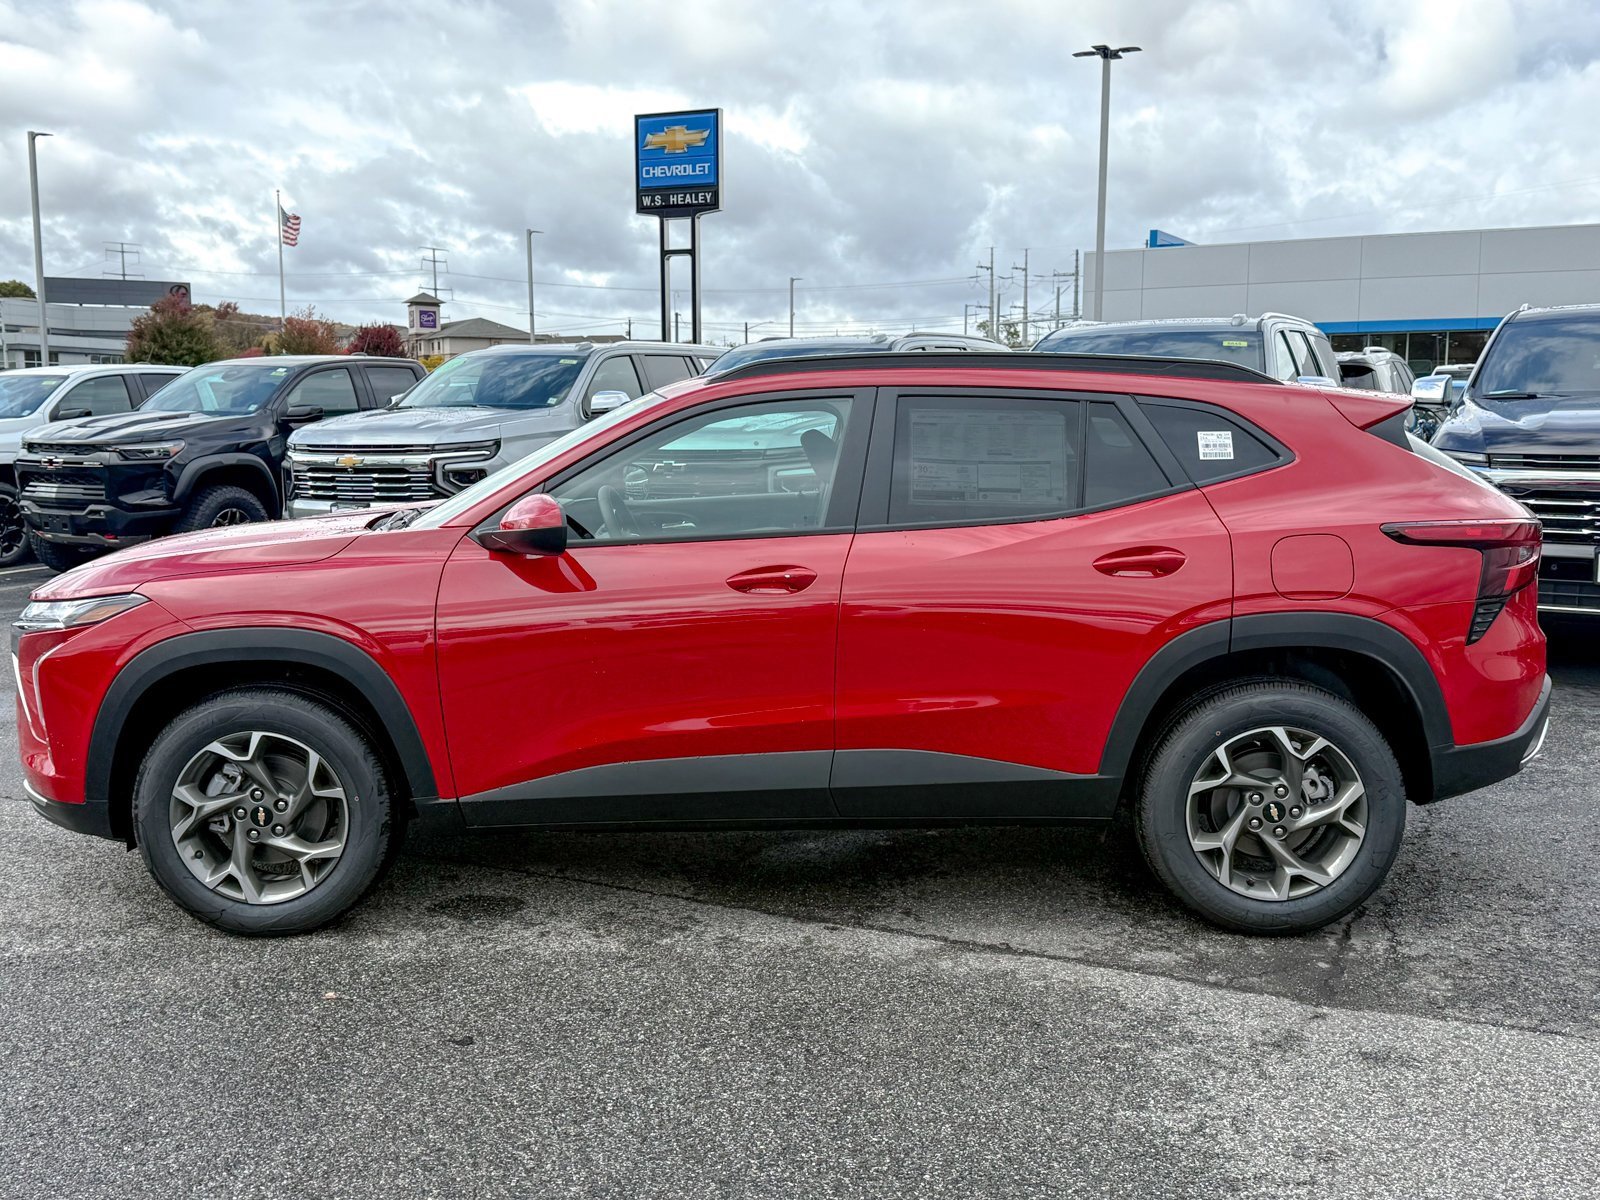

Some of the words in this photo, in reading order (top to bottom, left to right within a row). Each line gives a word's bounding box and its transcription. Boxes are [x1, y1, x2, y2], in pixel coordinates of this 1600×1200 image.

[642, 163, 710, 178] CHEVROLET
[642, 195, 665, 206] W.S.
[670, 192, 712, 205] HEALEY
